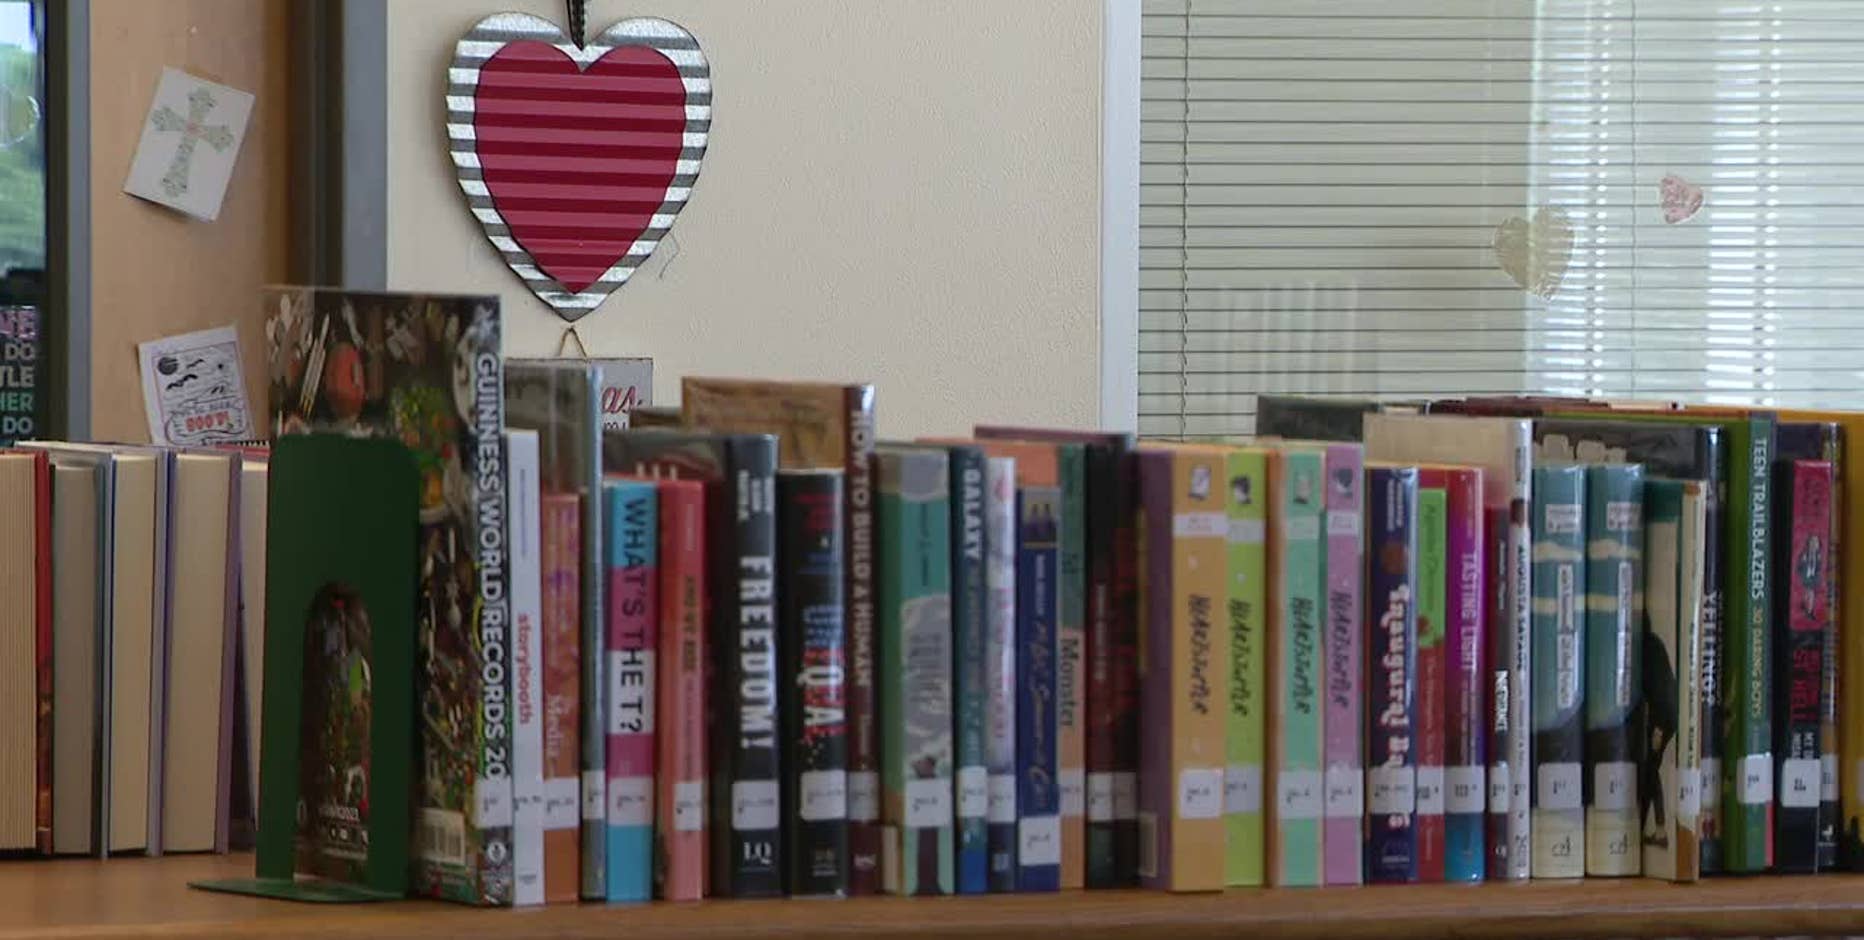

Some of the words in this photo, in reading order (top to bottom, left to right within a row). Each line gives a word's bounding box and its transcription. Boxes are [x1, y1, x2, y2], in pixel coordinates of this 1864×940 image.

[5, 343, 35, 360] DO
[3, 417, 33, 434] DO
[477, 352, 502, 492] GUINNESS
[851, 409, 871, 467] HOW
[853, 474, 871, 507] TO
[1753, 438, 1768, 478] TEEN
[853, 511, 872, 579] BUILD
[963, 468, 981, 560] GALAXY
[1751, 484, 1767, 600] TRAILBLAZERS
[478, 498, 504, 601] WORLD
[622, 498, 647, 617] WHAT'S
[854, 584, 871, 598] A
[482, 606, 506, 741] RECORDS
[518, 614, 534, 725] storybooth
[620, 632, 644, 687] THE
[740, 556, 774, 750] FREEDOM!
[854, 602, 873, 687] HUMAN
[1751, 627, 1763, 677] DARING
[1059, 637, 1079, 727] Monster
[1751, 680, 1763, 720] BOYS
[620, 700, 643, 733] T?
